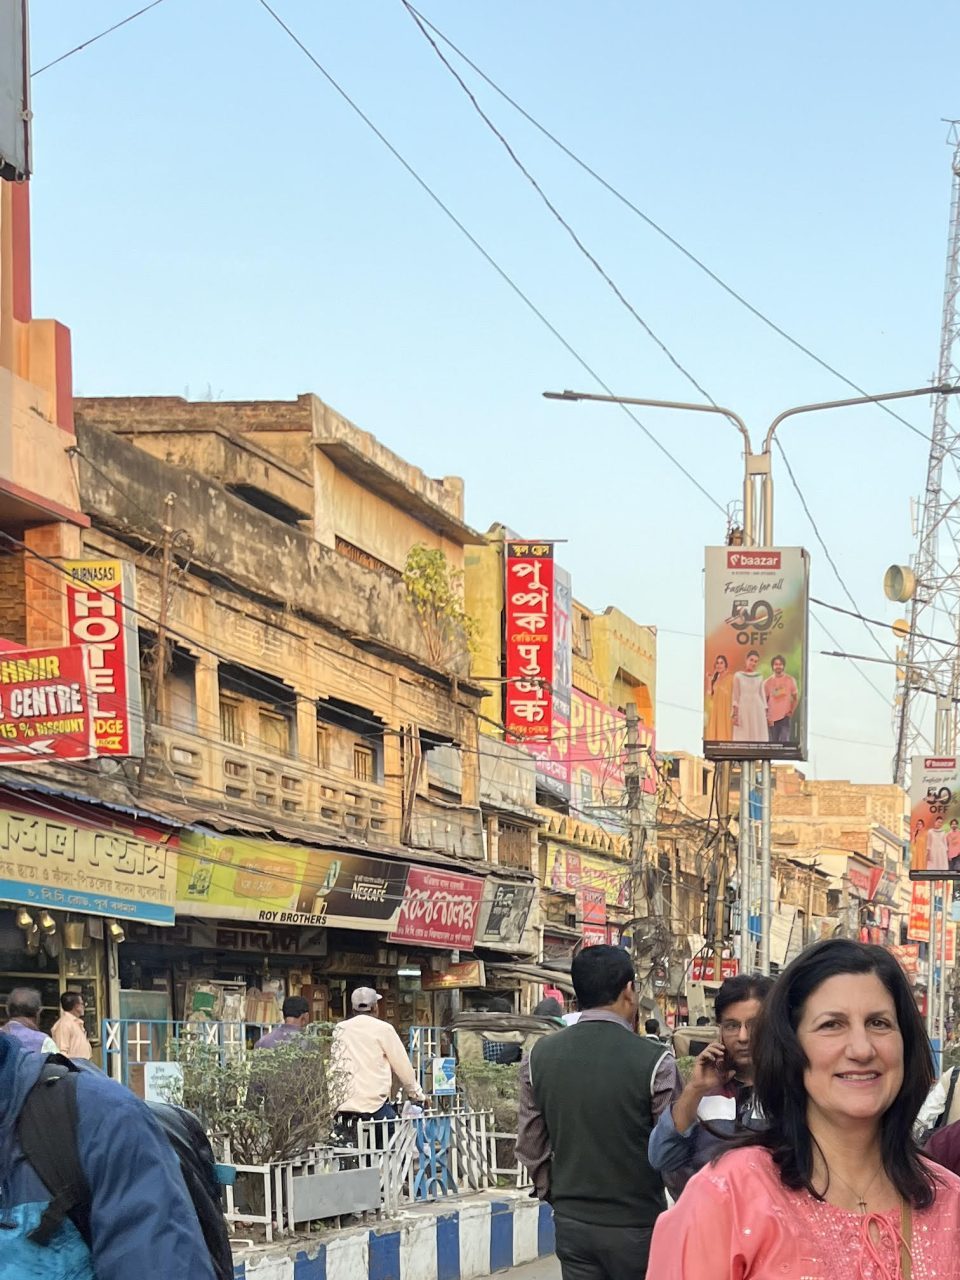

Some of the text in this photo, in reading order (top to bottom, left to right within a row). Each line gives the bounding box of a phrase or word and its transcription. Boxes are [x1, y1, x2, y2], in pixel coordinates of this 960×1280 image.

[724, 578, 784, 595] Fashion for all
[73, 591, 120, 718] HOTEL
[0, 655, 60, 684] HMIR
[10, 683, 84, 718] CENTRE
[94, 720, 124, 734] DGE
[258, 910, 328, 925] ROY BROTHERS
